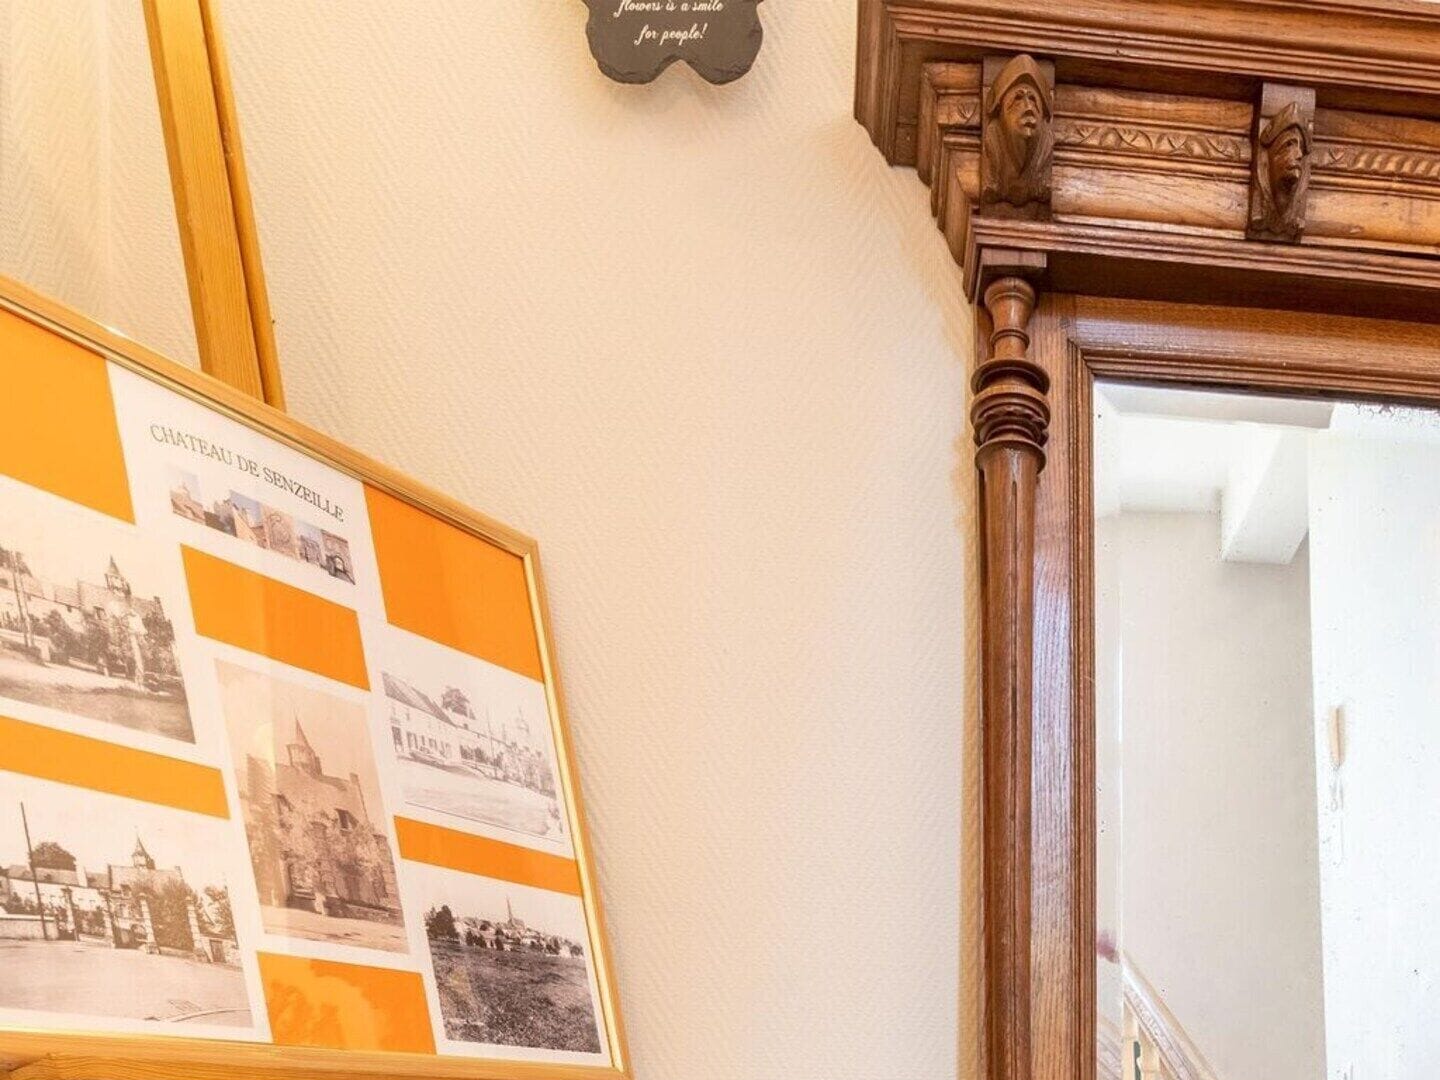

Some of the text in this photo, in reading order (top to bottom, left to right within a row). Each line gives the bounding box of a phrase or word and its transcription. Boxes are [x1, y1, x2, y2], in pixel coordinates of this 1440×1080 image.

[613, 0, 723, 18] flowers is a smile
[634, 23, 708, 46] for people!
[149, 423, 345, 523] CHATEAU DE SENZEILLE
